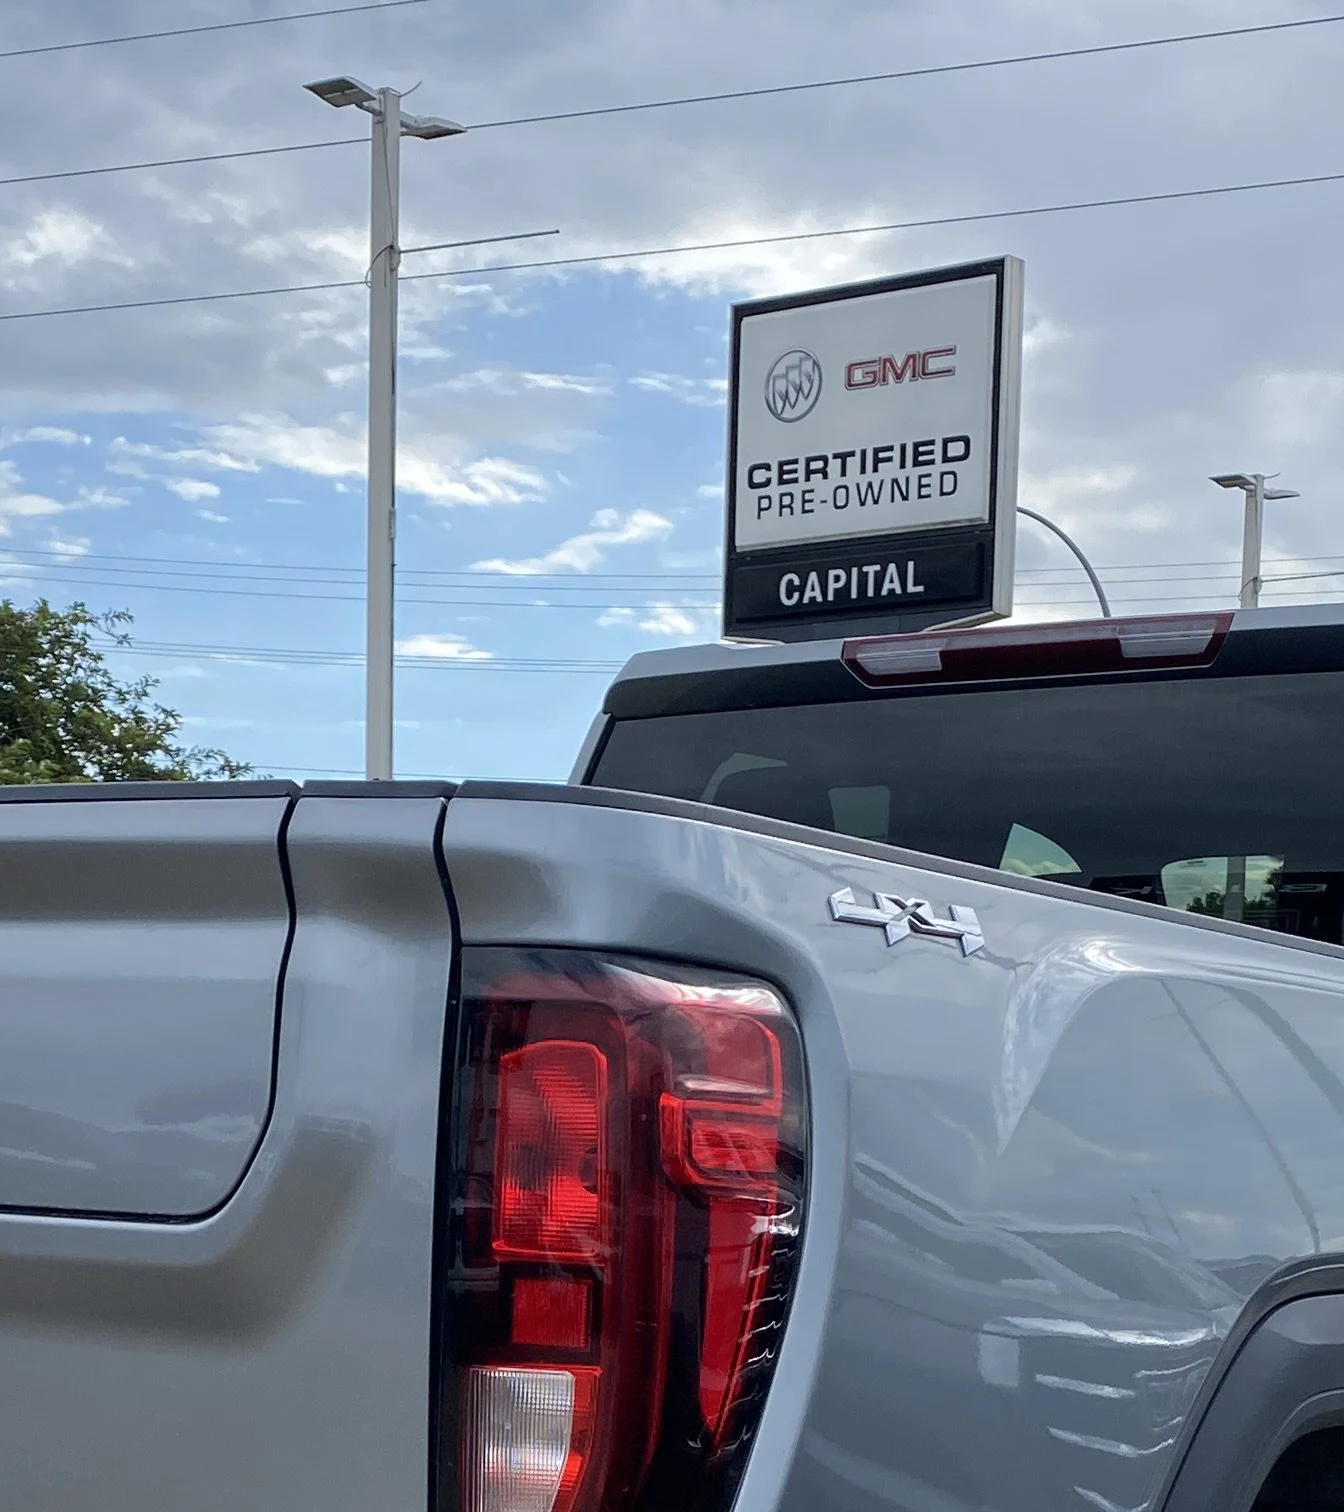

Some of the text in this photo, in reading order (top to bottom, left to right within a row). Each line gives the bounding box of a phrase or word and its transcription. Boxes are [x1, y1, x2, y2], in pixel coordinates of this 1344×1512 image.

[844, 345, 957, 391] GMC
[747, 434, 972, 490] CERTIFIED
[756, 470, 958, 520] PRE-OWNED
[778, 560, 925, 607] CAPITAL
